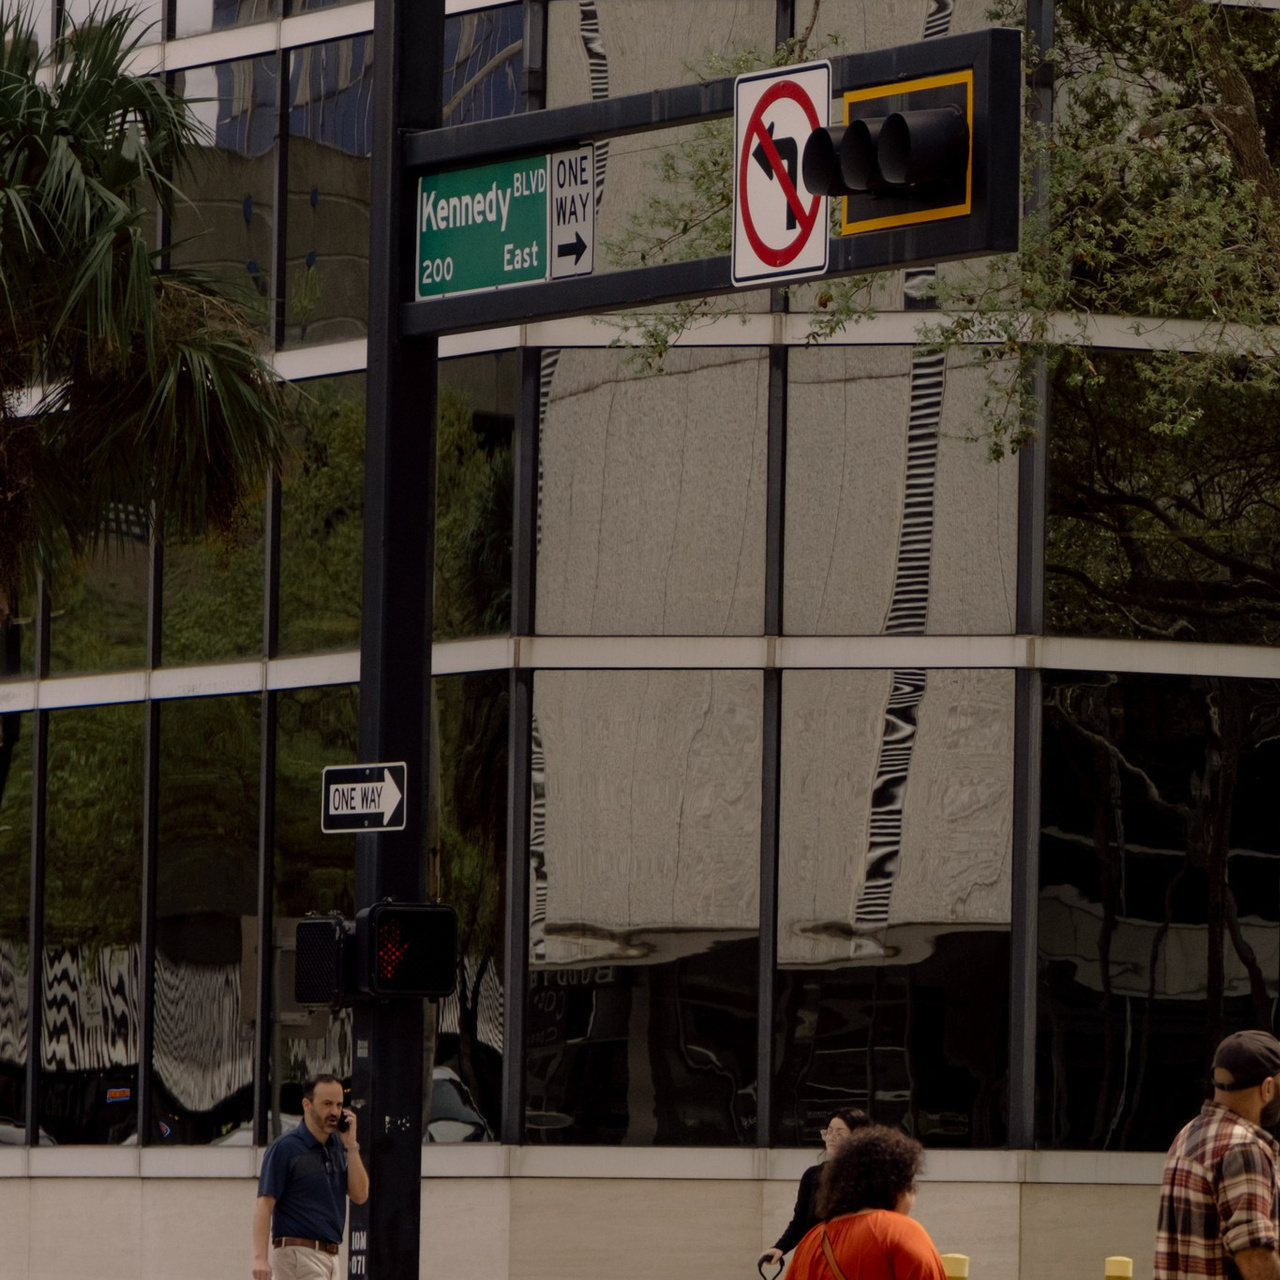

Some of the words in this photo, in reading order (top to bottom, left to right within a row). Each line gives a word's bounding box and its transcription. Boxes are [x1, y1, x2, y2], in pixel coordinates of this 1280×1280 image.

[557, 155, 589, 189] ONE
[422, 181, 511, 232] Kennedy
[513, 168, 546, 197] BLVD
[556, 192, 590, 226] WAY
[422, 257, 453, 284] 200
[504, 240, 538, 271] East
[332, 787, 356, 811] ONE
[360, 786, 383, 809] WAY
